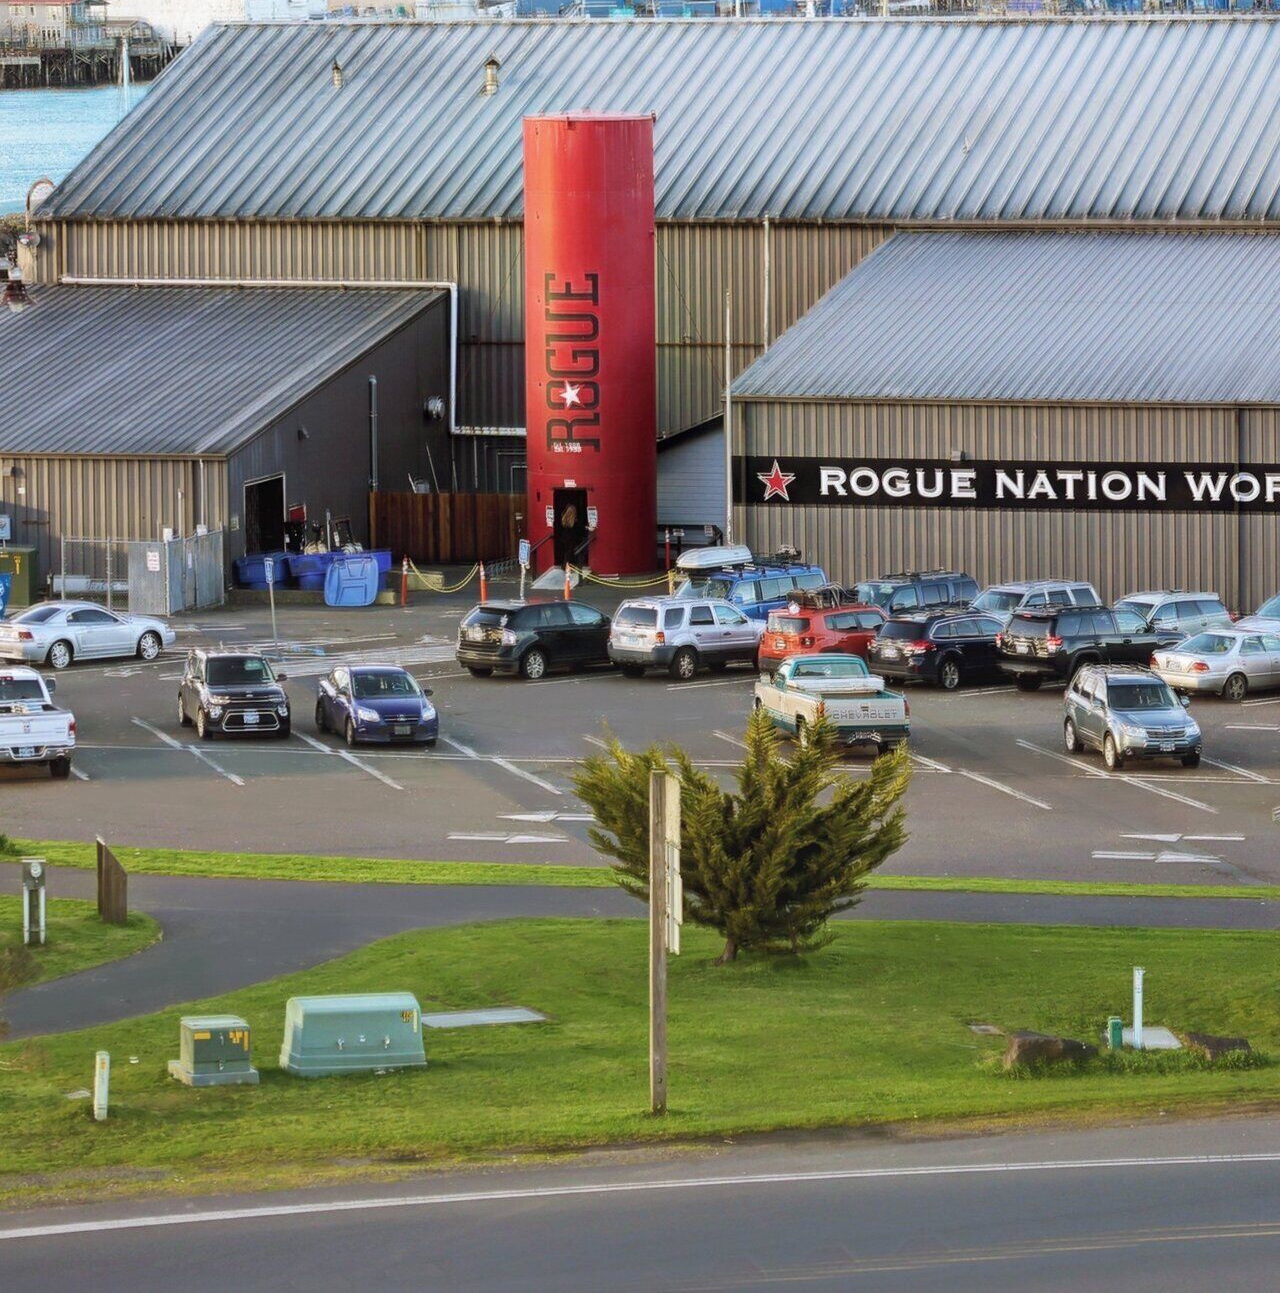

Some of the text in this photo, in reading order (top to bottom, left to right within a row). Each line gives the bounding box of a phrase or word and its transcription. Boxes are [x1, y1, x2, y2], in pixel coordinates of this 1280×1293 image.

[544, 273, 601, 453] ROGUE
[819, 466, 977, 499] ROGUE
[995, 469, 1167, 502] NATION
[832, 709, 898, 719] CHEVROLET
